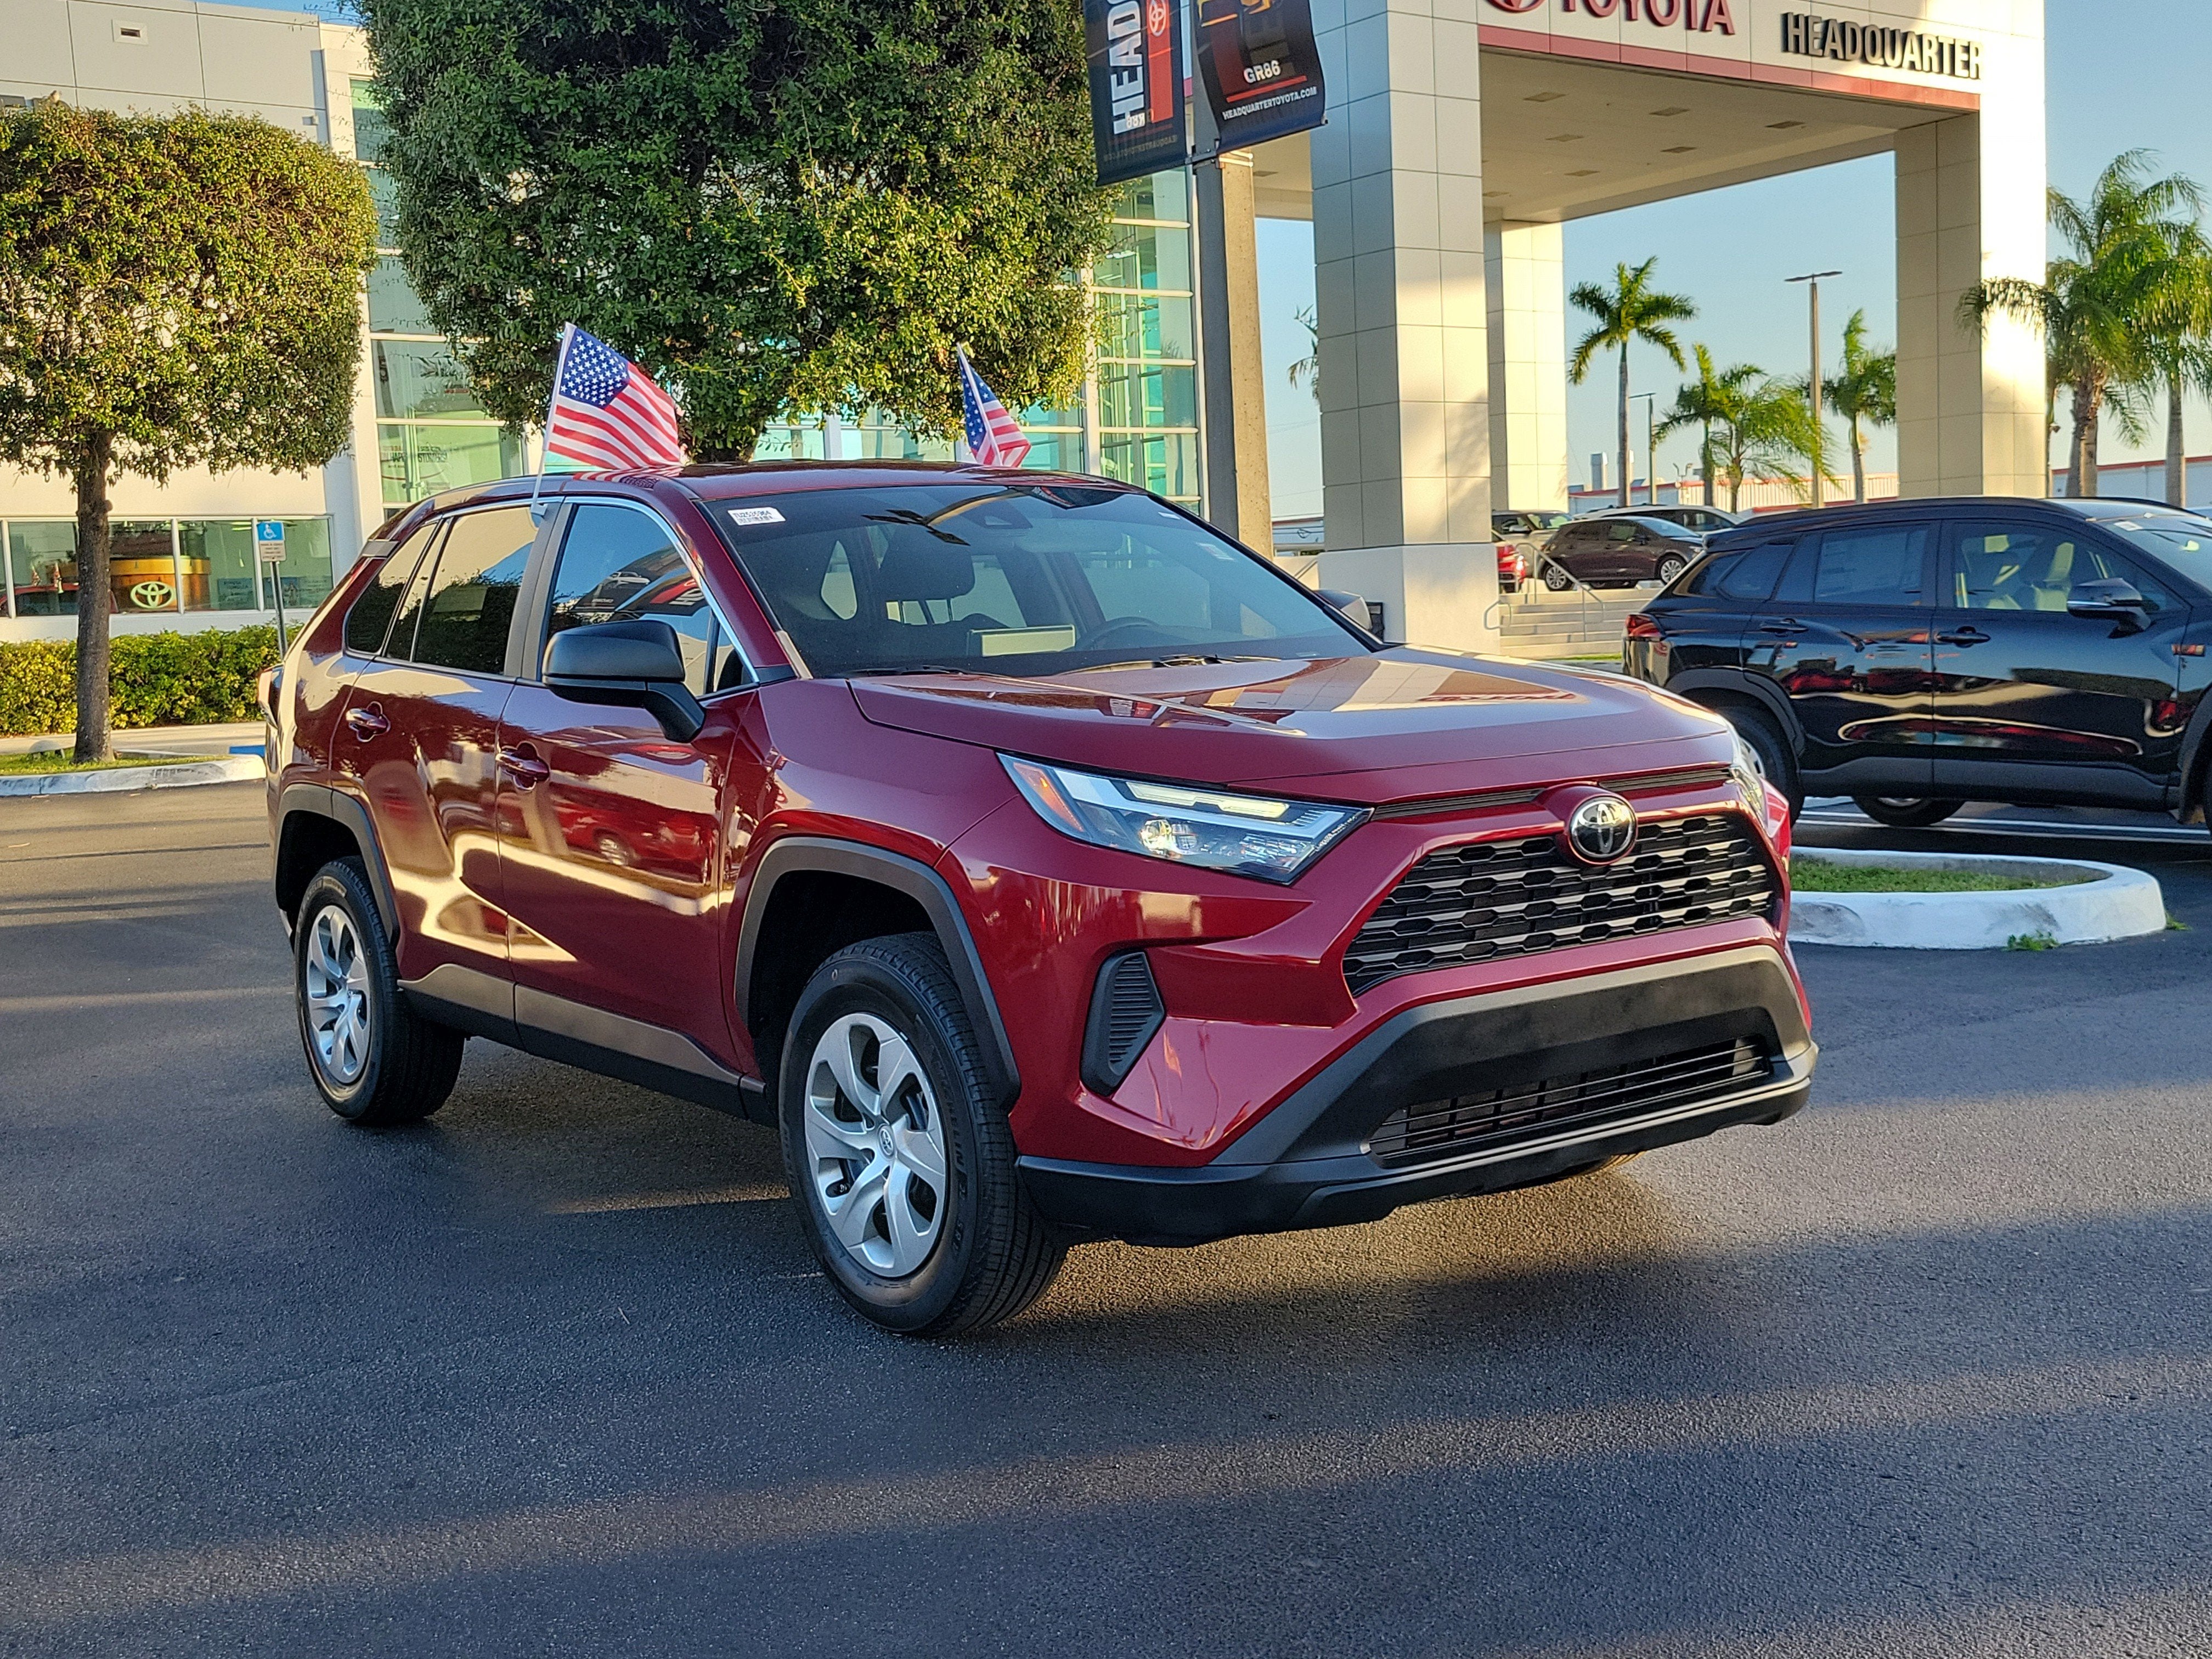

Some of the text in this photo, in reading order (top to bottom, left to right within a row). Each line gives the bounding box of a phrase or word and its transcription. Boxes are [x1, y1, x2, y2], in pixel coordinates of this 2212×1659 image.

[1107, 0, 1145, 134] HEAD
[1243, 59, 1282, 84] GR86
[1781, 12, 1983, 80] HEADQUARTER
[1222, 86, 1318, 120] HEADQUARTERTOYOTA.COM
